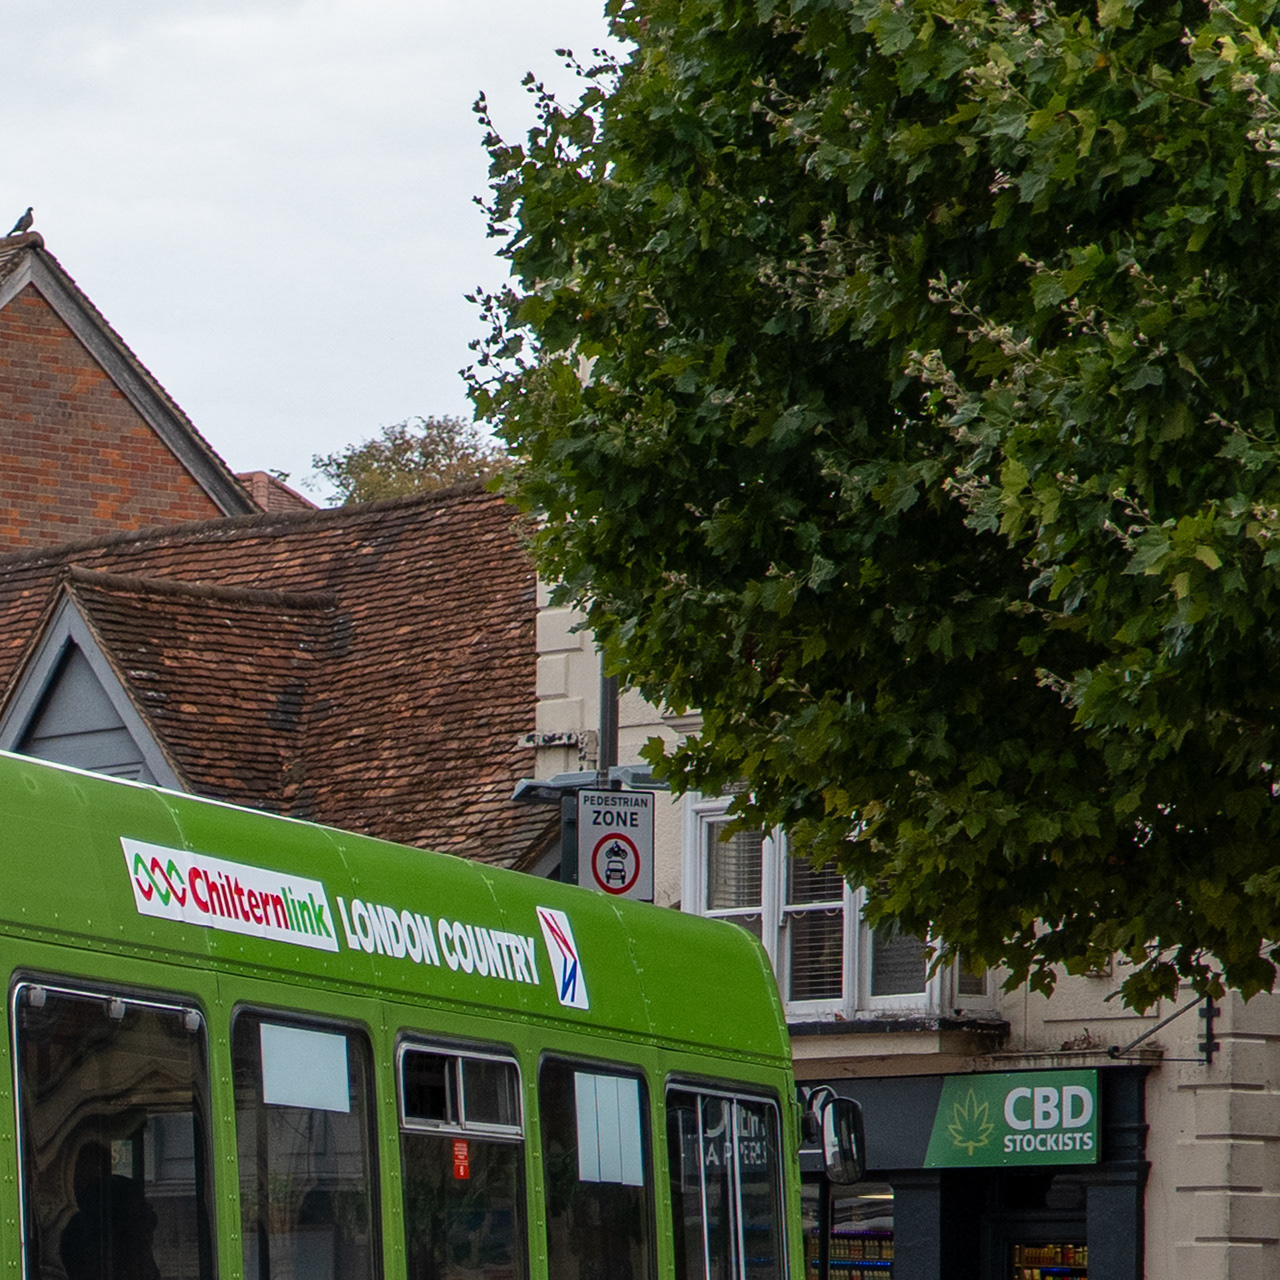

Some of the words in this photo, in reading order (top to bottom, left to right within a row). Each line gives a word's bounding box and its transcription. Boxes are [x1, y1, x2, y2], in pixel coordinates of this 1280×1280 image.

[583, 794, 649, 808] PEDESTRIAN
[592, 809, 639, 828] ZONE
[336, 896, 441, 967] LONDON
[438, 917, 540, 986] COUNTRY
[1003, 1085, 1094, 1131] CBD
[1003, 1131, 1094, 1153] STOCKISTS
